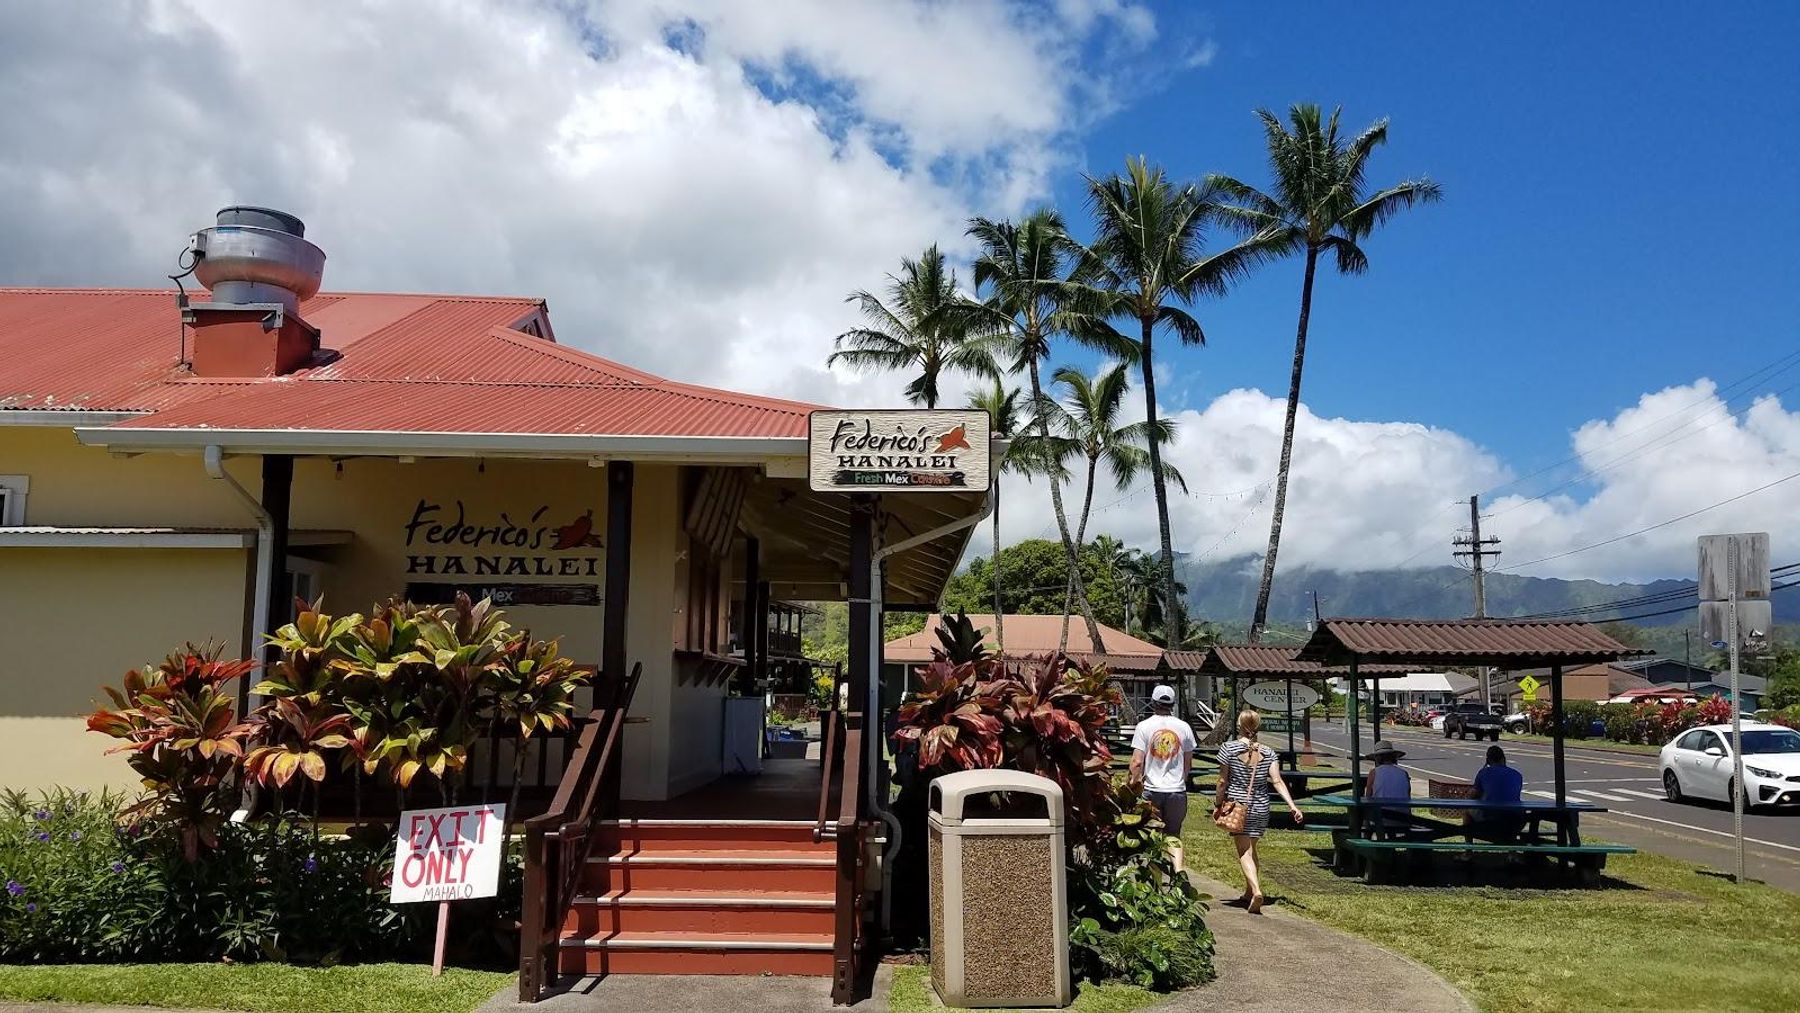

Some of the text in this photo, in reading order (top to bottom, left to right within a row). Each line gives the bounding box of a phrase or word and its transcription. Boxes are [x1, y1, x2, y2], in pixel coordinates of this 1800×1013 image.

[837, 455, 957, 468] HANALEI
[854, 472, 884, 484] Fresh
[885, 473, 909, 485] Mex
[406, 555, 598, 576] HANALEI
[482, 587, 513, 601] Mex
[1253, 688, 1299, 696] HANALI
[1263, 696, 1306, 704] CENER
[409, 809, 495, 851] EXIT
[401, 848, 474, 888] ONLY
[422, 883, 473, 901] MAHALO
